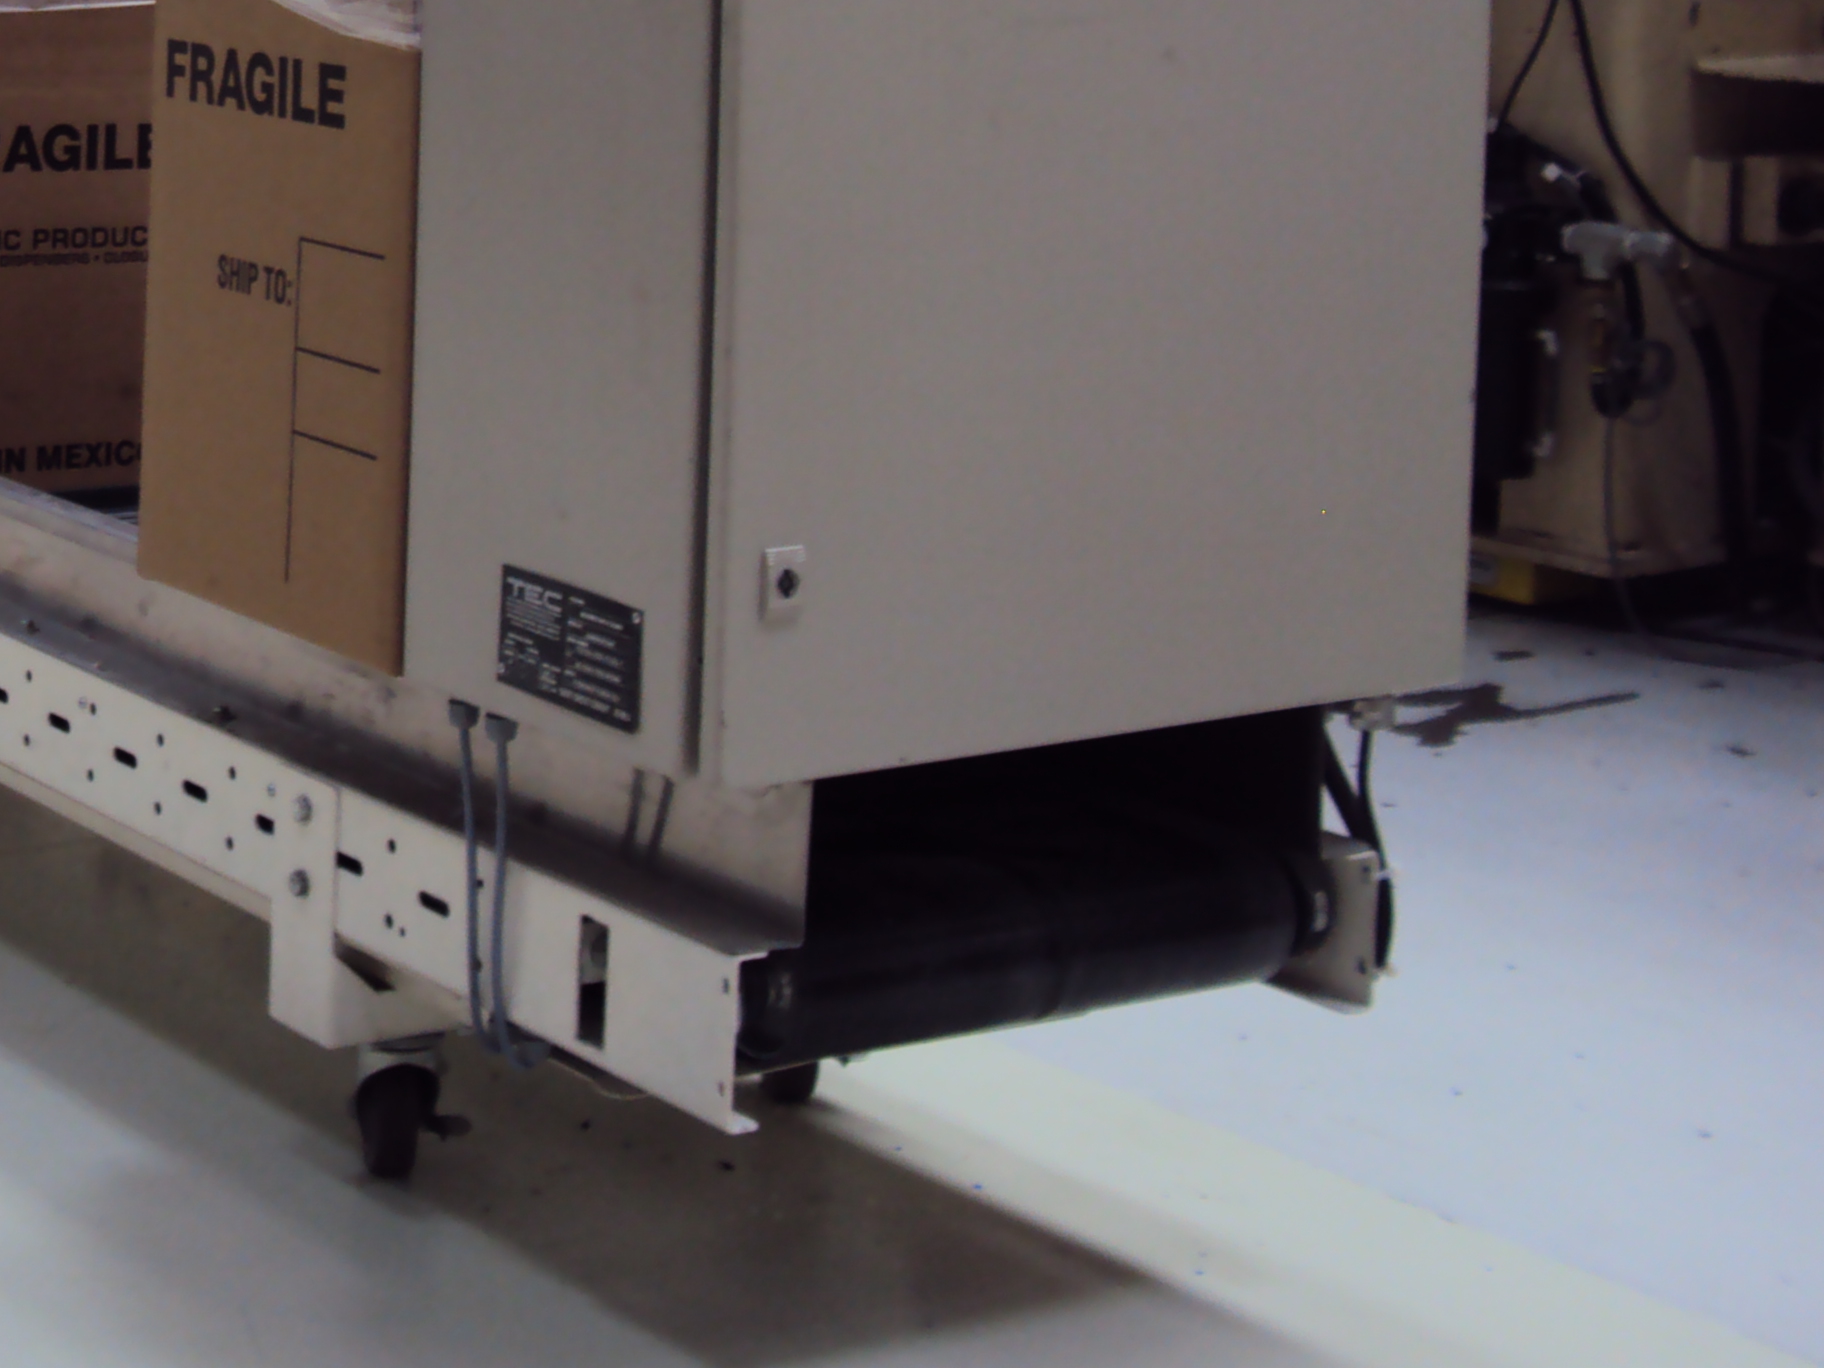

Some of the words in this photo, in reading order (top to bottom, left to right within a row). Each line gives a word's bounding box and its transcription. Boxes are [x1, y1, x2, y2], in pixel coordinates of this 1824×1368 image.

[166, 38, 347, 129] FRAGILE
[218, 254, 259, 296] SHIP
[263, 266, 293, 307] TO:
[36, 439, 142, 472] MEXIC
[507, 576, 563, 613] TEC
